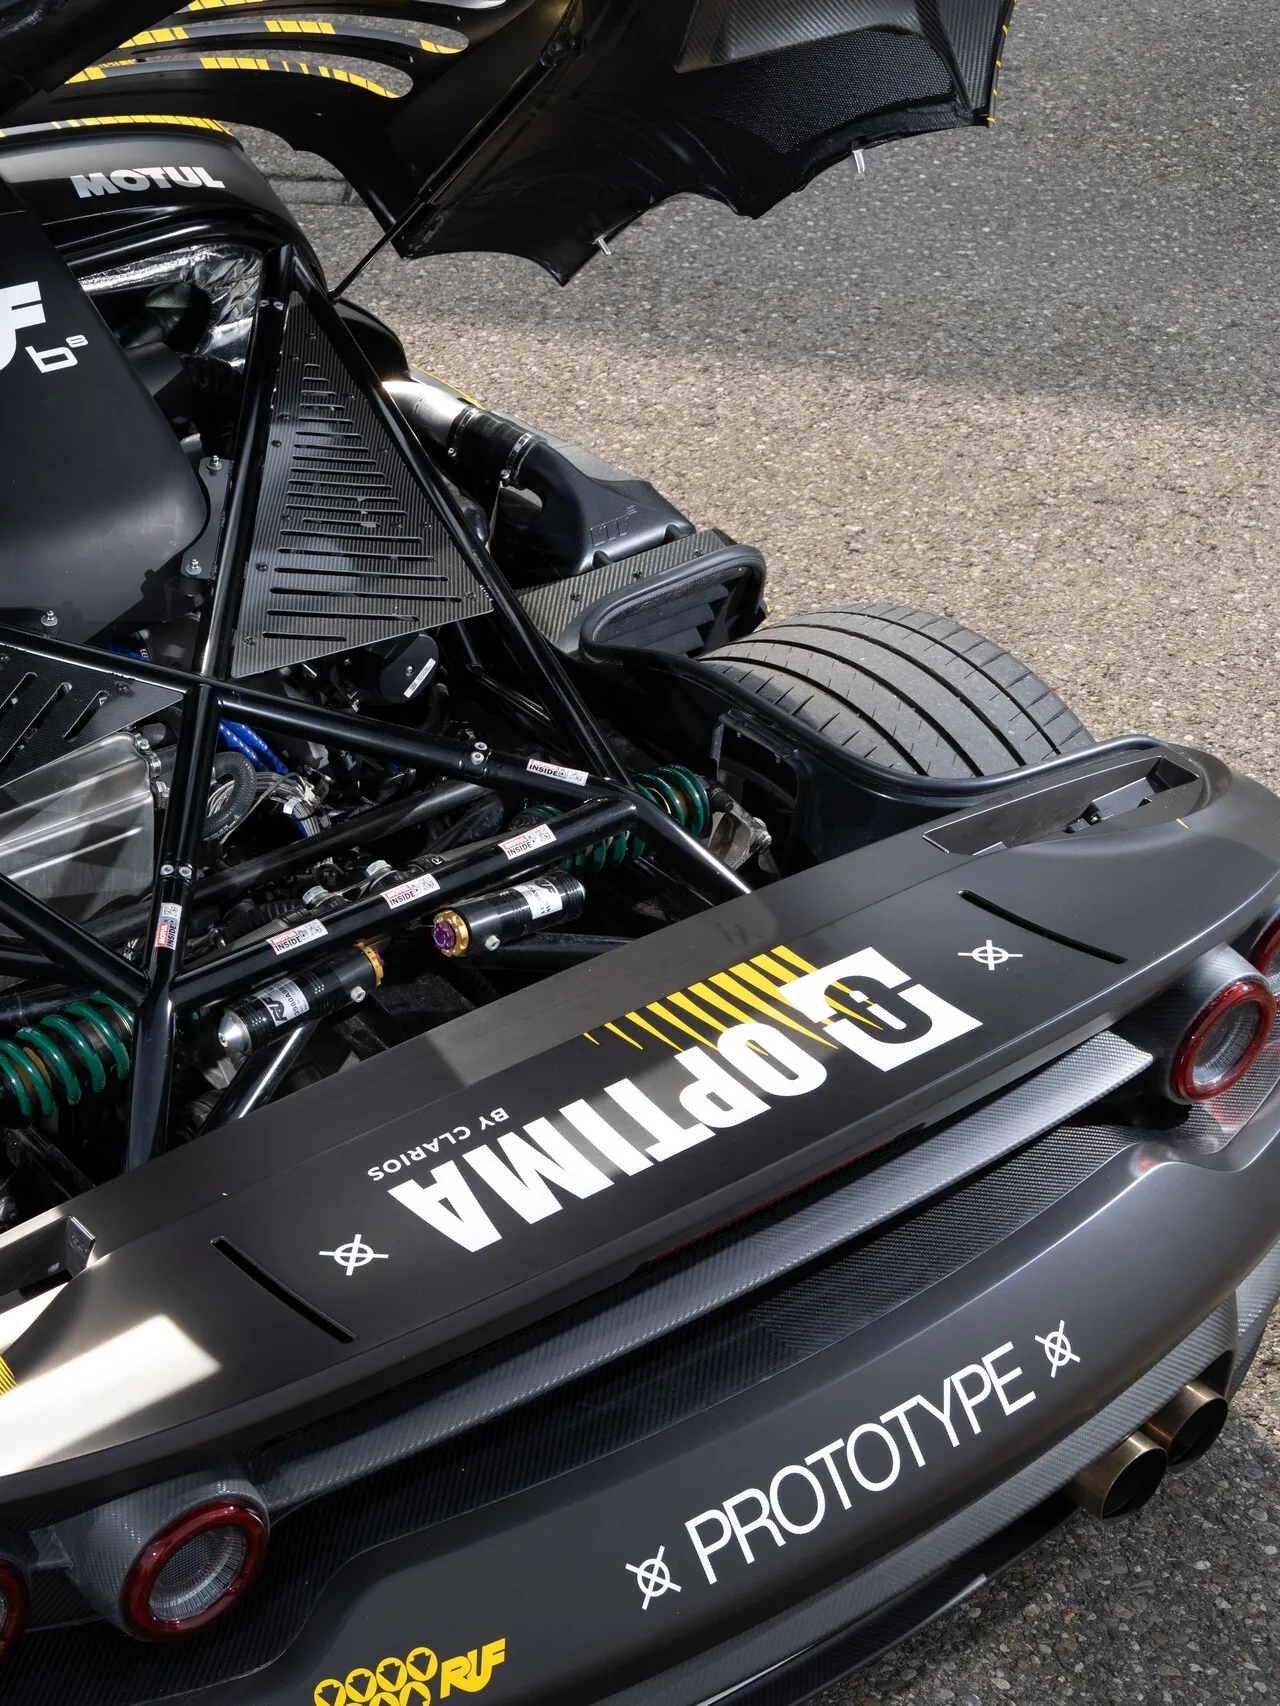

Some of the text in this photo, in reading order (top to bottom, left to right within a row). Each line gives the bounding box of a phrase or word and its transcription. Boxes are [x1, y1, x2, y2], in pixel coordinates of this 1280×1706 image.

[70, 166, 226, 199] MOTUL
[529, 764, 558, 777] INSIDE
[507, 842, 532, 856] INSIDE
[390, 891, 415, 905] INSIDE
[275, 936, 302, 952] INSIDE
[367, 1107, 510, 1181] BY CLARIOS
[387, 1022, 829, 1254] OPTIMA
[683, 1341, 1038, 1586] PROTOTYPE
[440, 1638, 506, 1699] RUF
